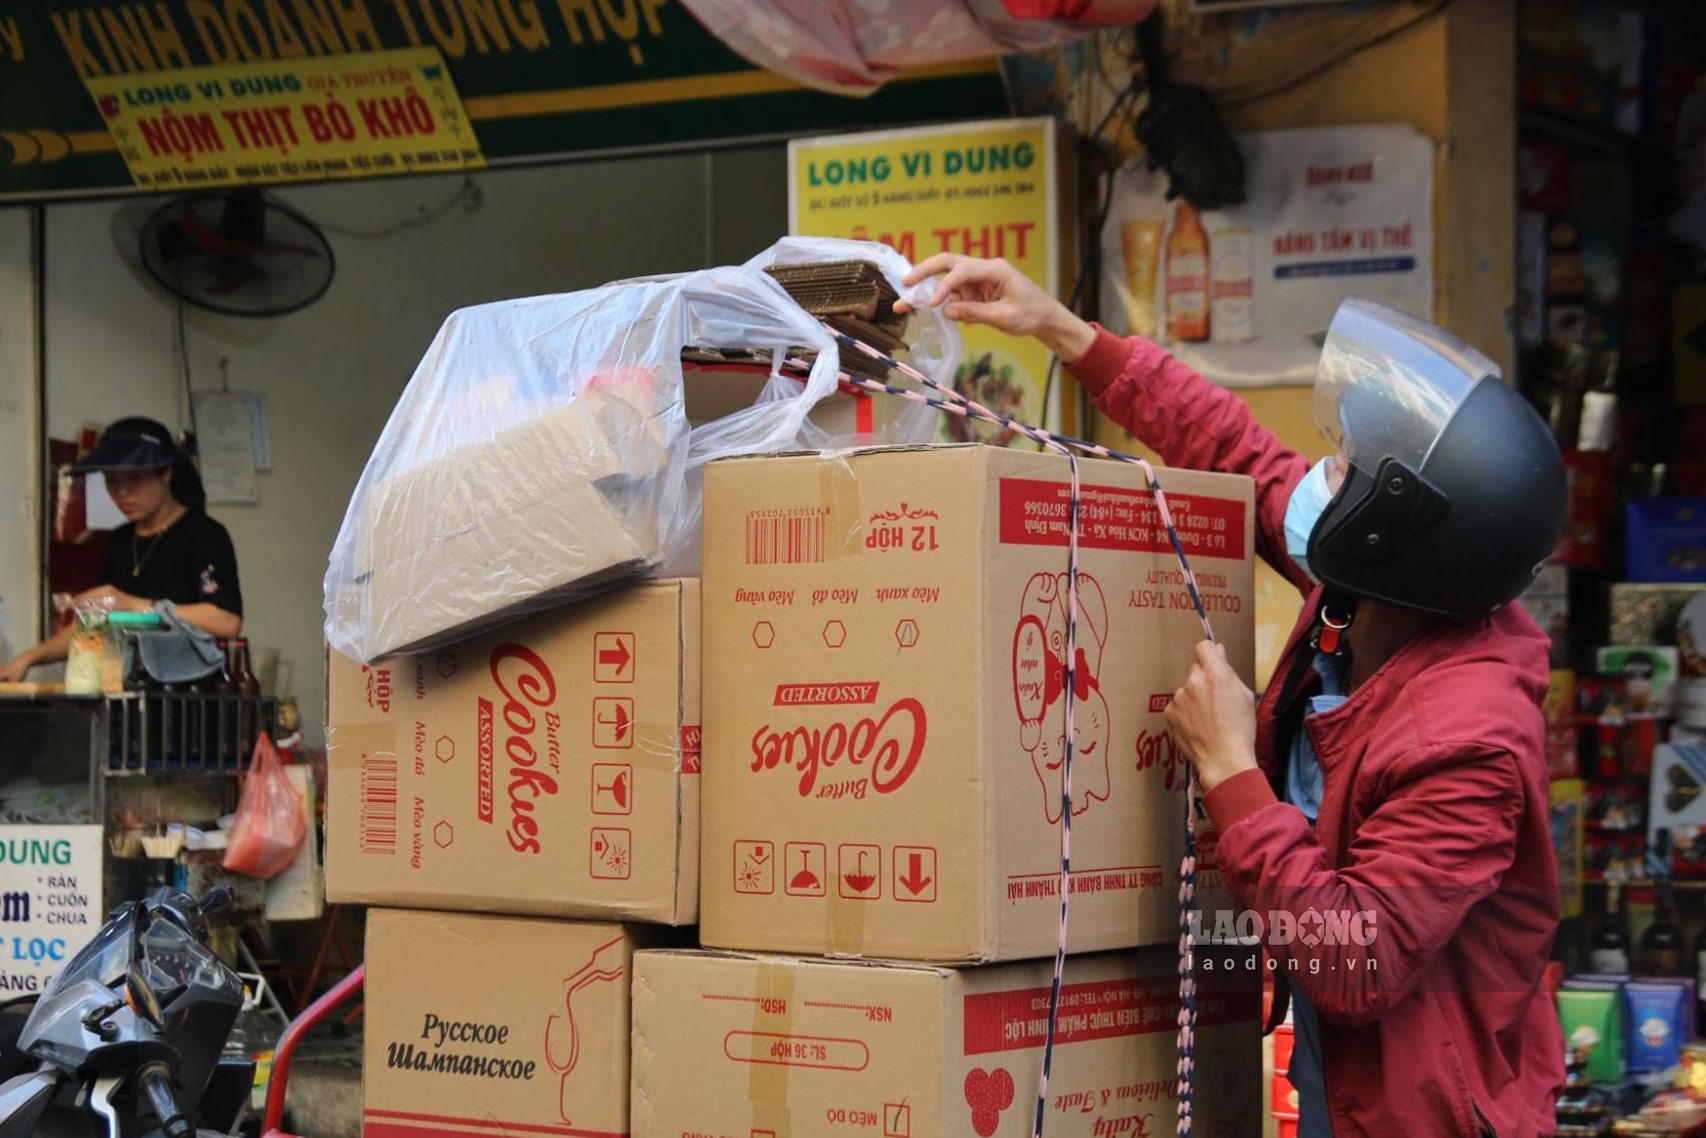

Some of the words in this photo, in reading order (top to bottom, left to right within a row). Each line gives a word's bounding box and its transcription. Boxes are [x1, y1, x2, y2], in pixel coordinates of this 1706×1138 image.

[50, 1, 192, 79] KINH
[124, 84, 191, 107] LONG
[198, 79, 222, 101] VI
[231, 74, 301, 96] DUNG
[137, 107, 225, 164] NỘM
[223, 105, 299, 156] THỊT
[303, 92, 355, 143] BÒ
[360, 87, 437, 140] KHÔ
[807, 156, 891, 187] LONG
[902, 151, 931, 178] VI
[944, 142, 1034, 175] DUNG
[1024, 501, 1066, 516] 3670366
[1089, 505, 1113, 520] (+84)
[1115, 508, 1133, 521] Fax:
[1141, 511, 1156, 524] 134
[1024, 515, 1046, 534] Định
[1048, 523, 1070, 535] Nam
[1128, 528, 1148, 541] KCN
[865, 521, 903, 552] HỘP
[912, 525, 940, 551] 12
[1147, 570, 1182, 585] QUALITY
[734, 588, 765, 605] vàng
[769, 589, 795, 605] Mèo
[811, 588, 829, 606] đỏ
[831, 588, 859, 605] Mèo
[876, 588, 911, 602] xanh
[912, 587, 940, 604] Mèo
[1129, 589, 1164, 608] TASTY
[374, 669, 393, 714] HỘP
[780, 685, 872, 703] ASSORTED
[415, 721, 426, 753] Mèo
[545, 710, 561, 775] Butter
[751, 698, 927, 797] Cookies
[490, 643, 558, 854] Cookies
[479, 706, 491, 817] ASSORTED
[815, 778, 869, 800] Butter
[413, 796, 424, 828] Mèo
[410, 831, 424, 870] vàng
[1078, 875, 1101, 895] BÁNH
[1104, 874, 1126, 889] TNHH
[1128, 873, 1137, 889] TY
[13, 936, 67, 967] LỌC
[0, 970, 38, 991] ÀNG
[1058, 1014, 1087, 1041] PHẨM
[1089, 1008, 1114, 1029] THỰC
[1117, 1008, 1139, 1029] BIẾN
[421, 1013, 509, 1047] Русское
[1004, 1017, 1025, 1042] LỘC
[387, 1042, 536, 1081] Шампанское
[770, 1039, 792, 1064] HỘP
[795, 1043, 807, 1060] 36
[810, 1045, 826, 1060] SL:
[1053, 1090, 1095, 1113] Taste
[1101, 1088, 1111, 1106] &
[849, 1110, 877, 1126] MÈO
